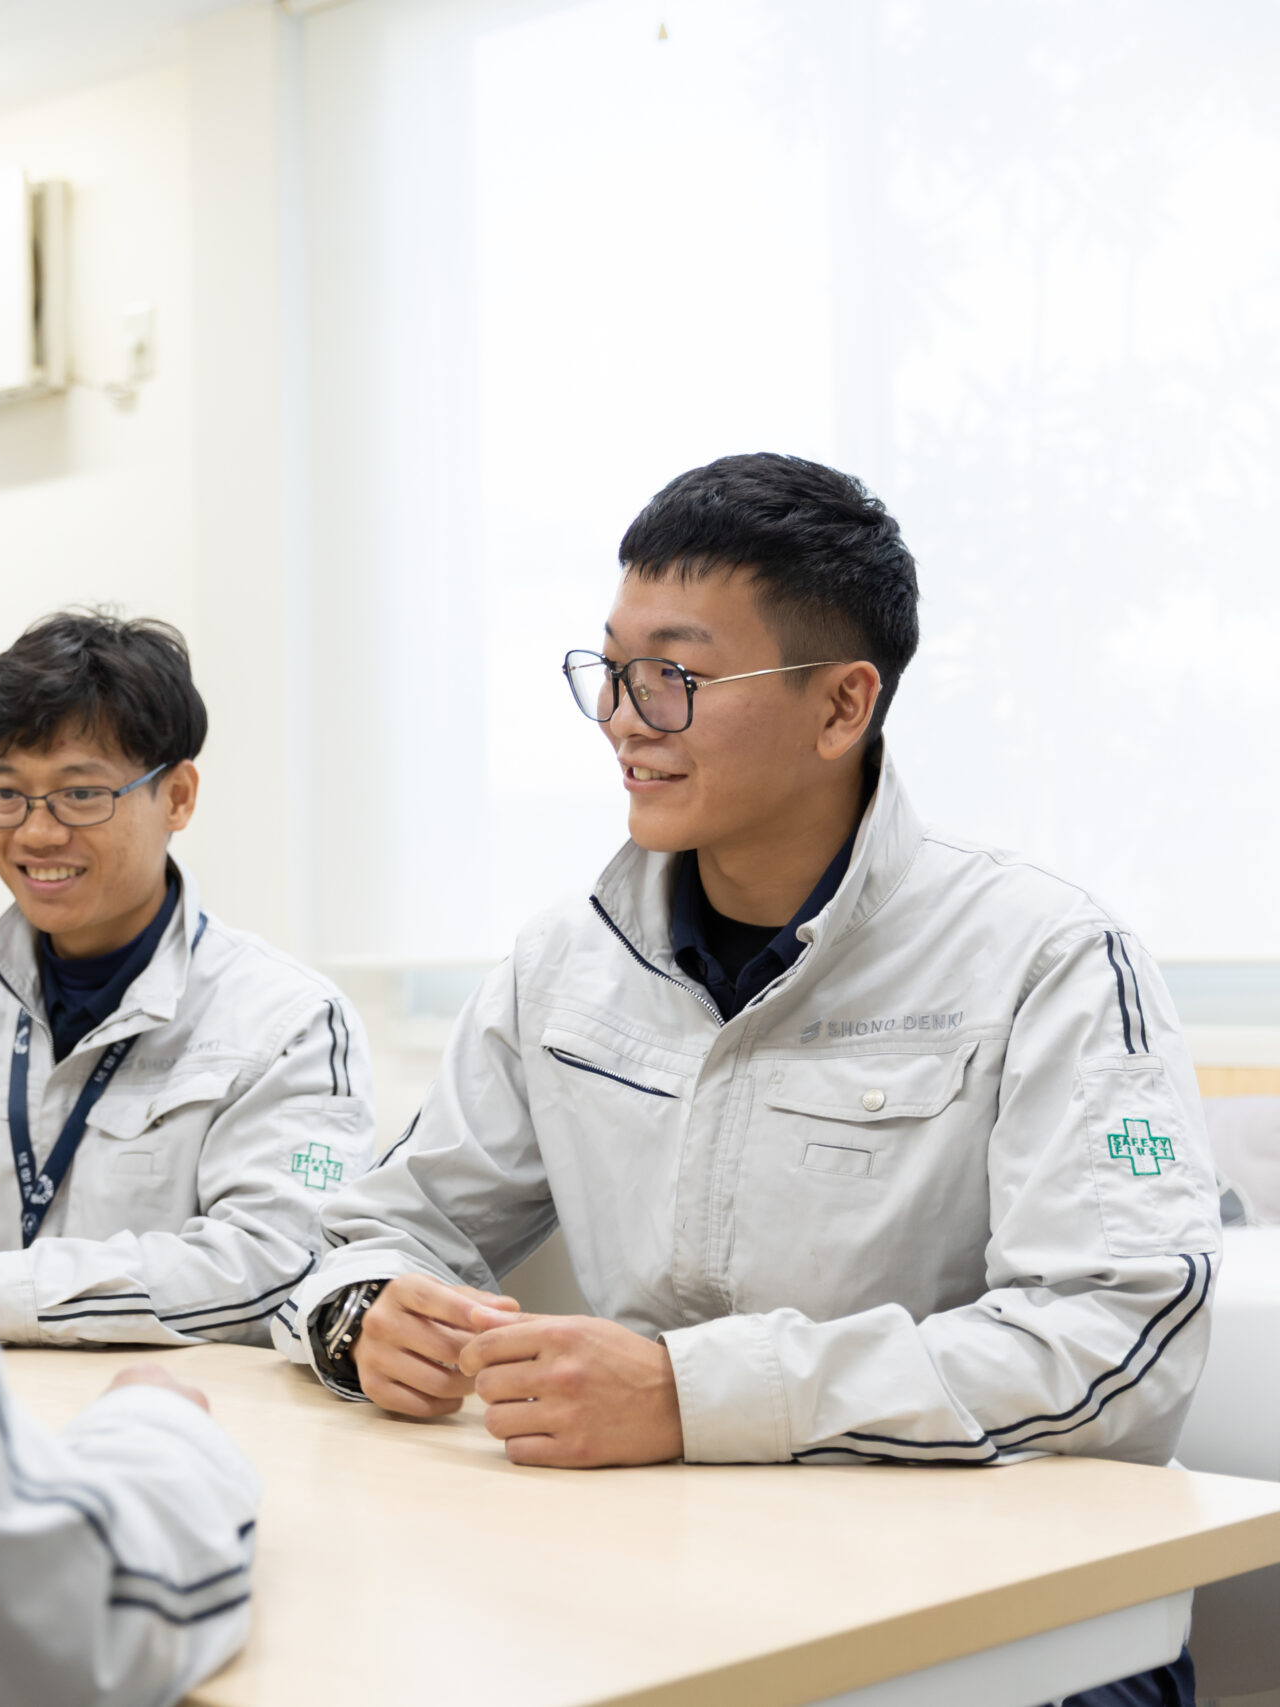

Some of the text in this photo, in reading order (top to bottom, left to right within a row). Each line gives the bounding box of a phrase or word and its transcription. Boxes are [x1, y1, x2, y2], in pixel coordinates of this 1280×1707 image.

[827, 1011, 963, 1038] SHONO DENKI
[1112, 1135, 1169, 1148] SAFETY
[1115, 1146, 1169, 1156] FIRST
